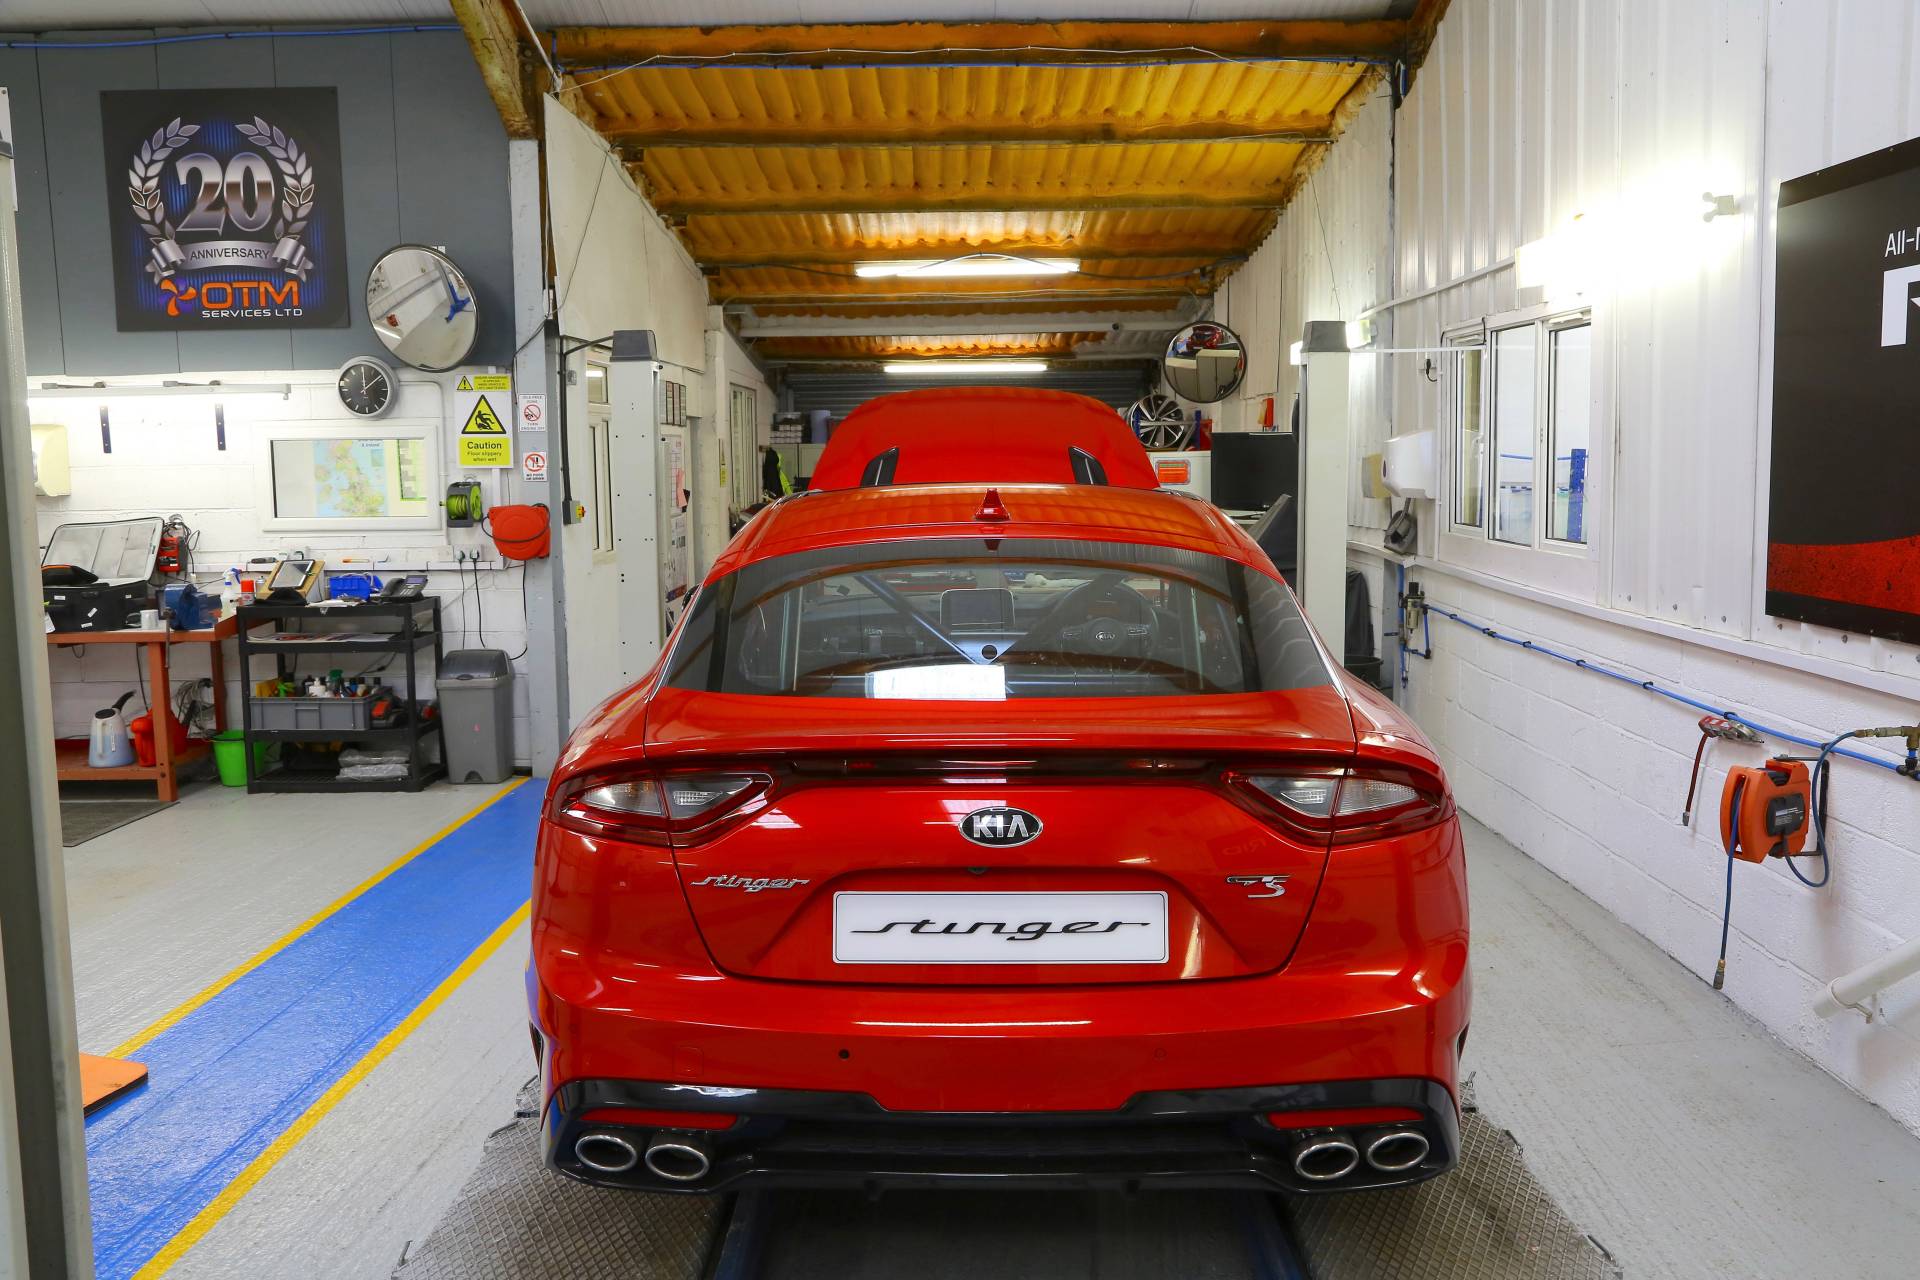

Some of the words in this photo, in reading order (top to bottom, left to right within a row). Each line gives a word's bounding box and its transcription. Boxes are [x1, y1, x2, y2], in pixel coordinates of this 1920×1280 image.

[175, 152, 275, 237] 20
[190, 248, 270, 261] ANNIVERSARY
[201, 280, 299, 309] OTM
[202, 309, 272, 318] SERVICES
[275, 308, 303, 317] LTD
[467, 441, 502, 450] Caution
[972, 815, 1029, 838] KIA
[850, 918, 1151, 941] stinger
